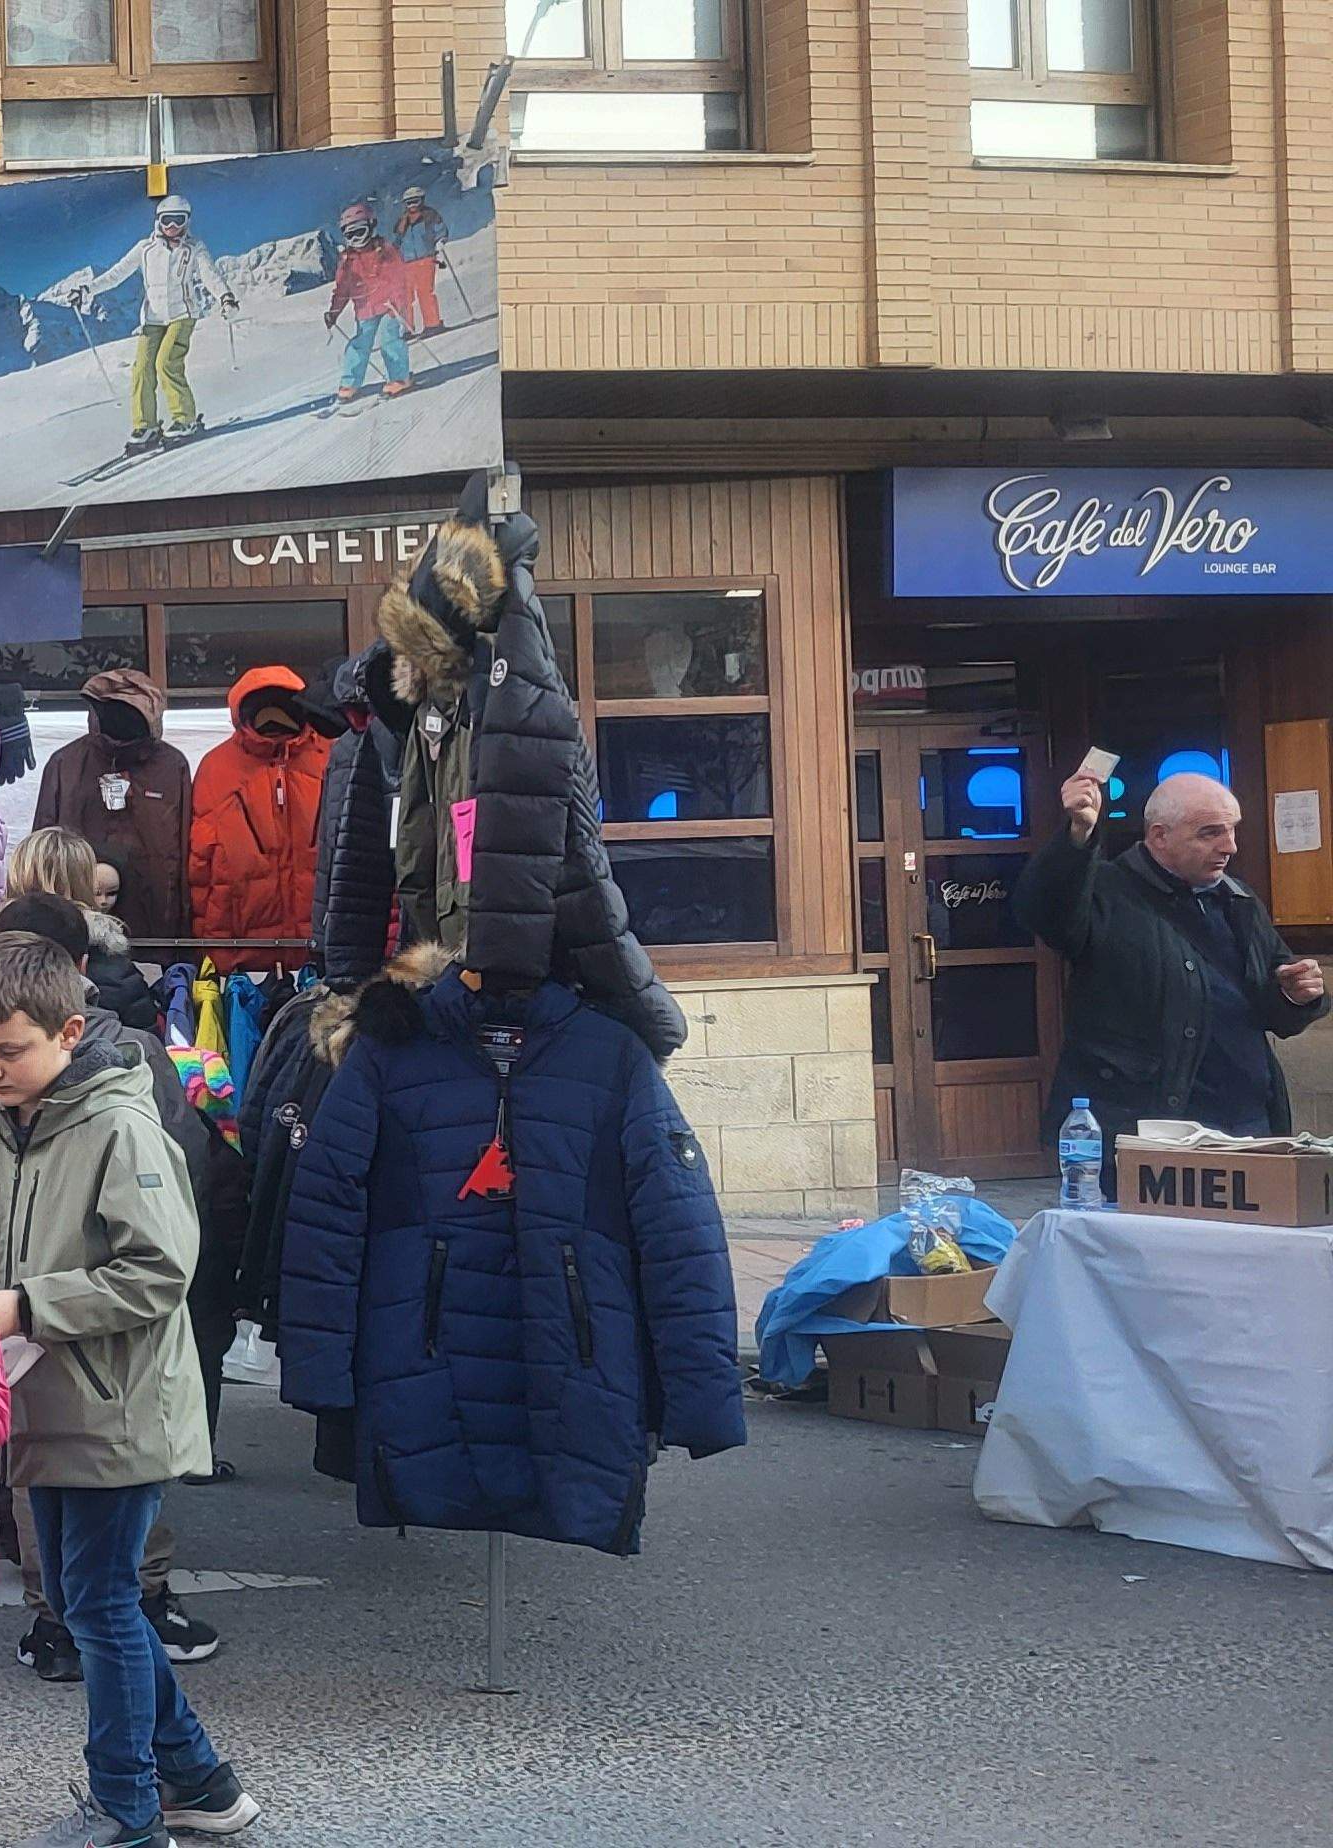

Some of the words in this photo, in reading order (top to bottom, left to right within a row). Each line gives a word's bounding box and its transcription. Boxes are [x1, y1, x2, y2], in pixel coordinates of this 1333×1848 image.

[233, 523, 440, 566] CAFETE
[988, 474, 1114, 590] Café
[1109, 507, 1152, 547] del
[1139, 476, 1259, 577] Vero
[1204, 562, 1249, 575] LOUNGE
[1252, 562, 1277, 575] BAR
[1138, 1164, 1260, 1212] MIEL
